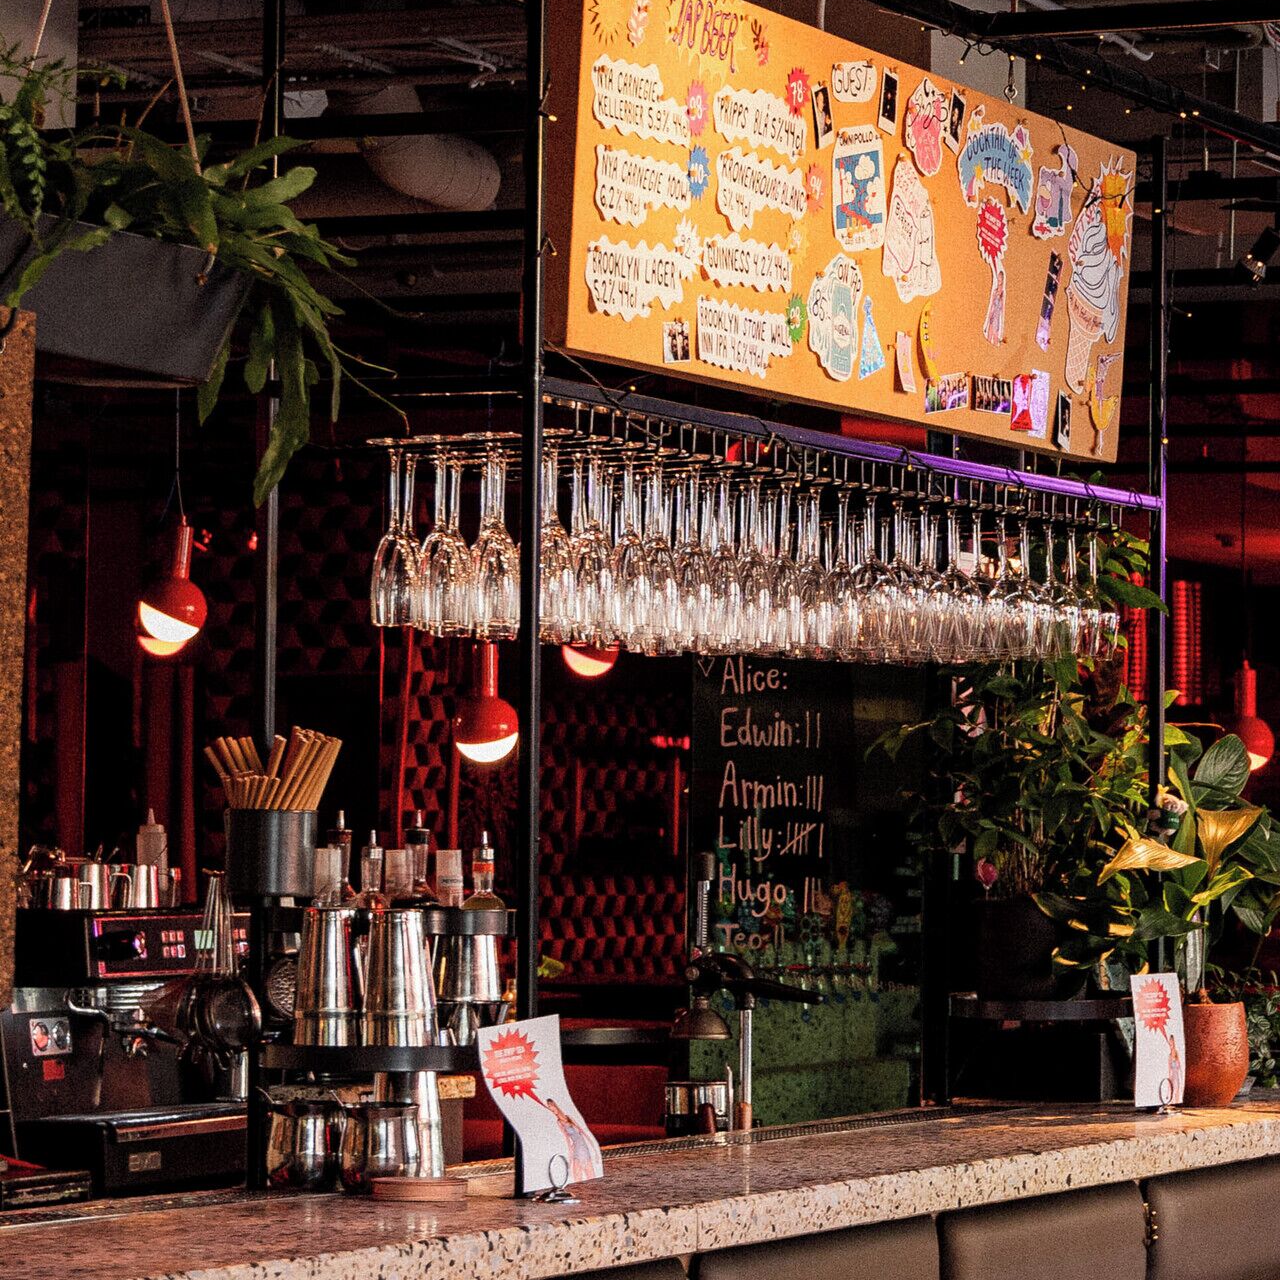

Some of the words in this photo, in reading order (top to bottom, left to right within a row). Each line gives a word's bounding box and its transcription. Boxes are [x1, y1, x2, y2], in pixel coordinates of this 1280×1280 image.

[700, 1, 739, 74] BEER
[617, 71, 659, 103] CARNEGIE
[597, 93, 644, 129] KELLERBIER
[720, 97, 749, 130] PRIPPS
[966, 126, 1007, 162] COCKTAIL
[601, 153, 618, 181] NYA
[621, 160, 664, 195] CARNEGIE
[721, 156, 781, 202] KRONENBOURG
[983, 156, 1003, 181] THE
[1003, 161, 1026, 192] WEEK
[592, 251, 640, 282] BROOKLYN
[644, 258, 676, 290] LAGER
[708, 244, 751, 274] GUINNESS
[837, 263, 850, 284] ON
[700, 305, 739, 335] BROOKLYN
[743, 316, 766, 342] STONE
[720, 656, 788, 695] Alice:
[719, 707, 800, 748] Edwin:
[718, 760, 803, 810] Armin:
[719, 815, 783, 863] Lilly:
